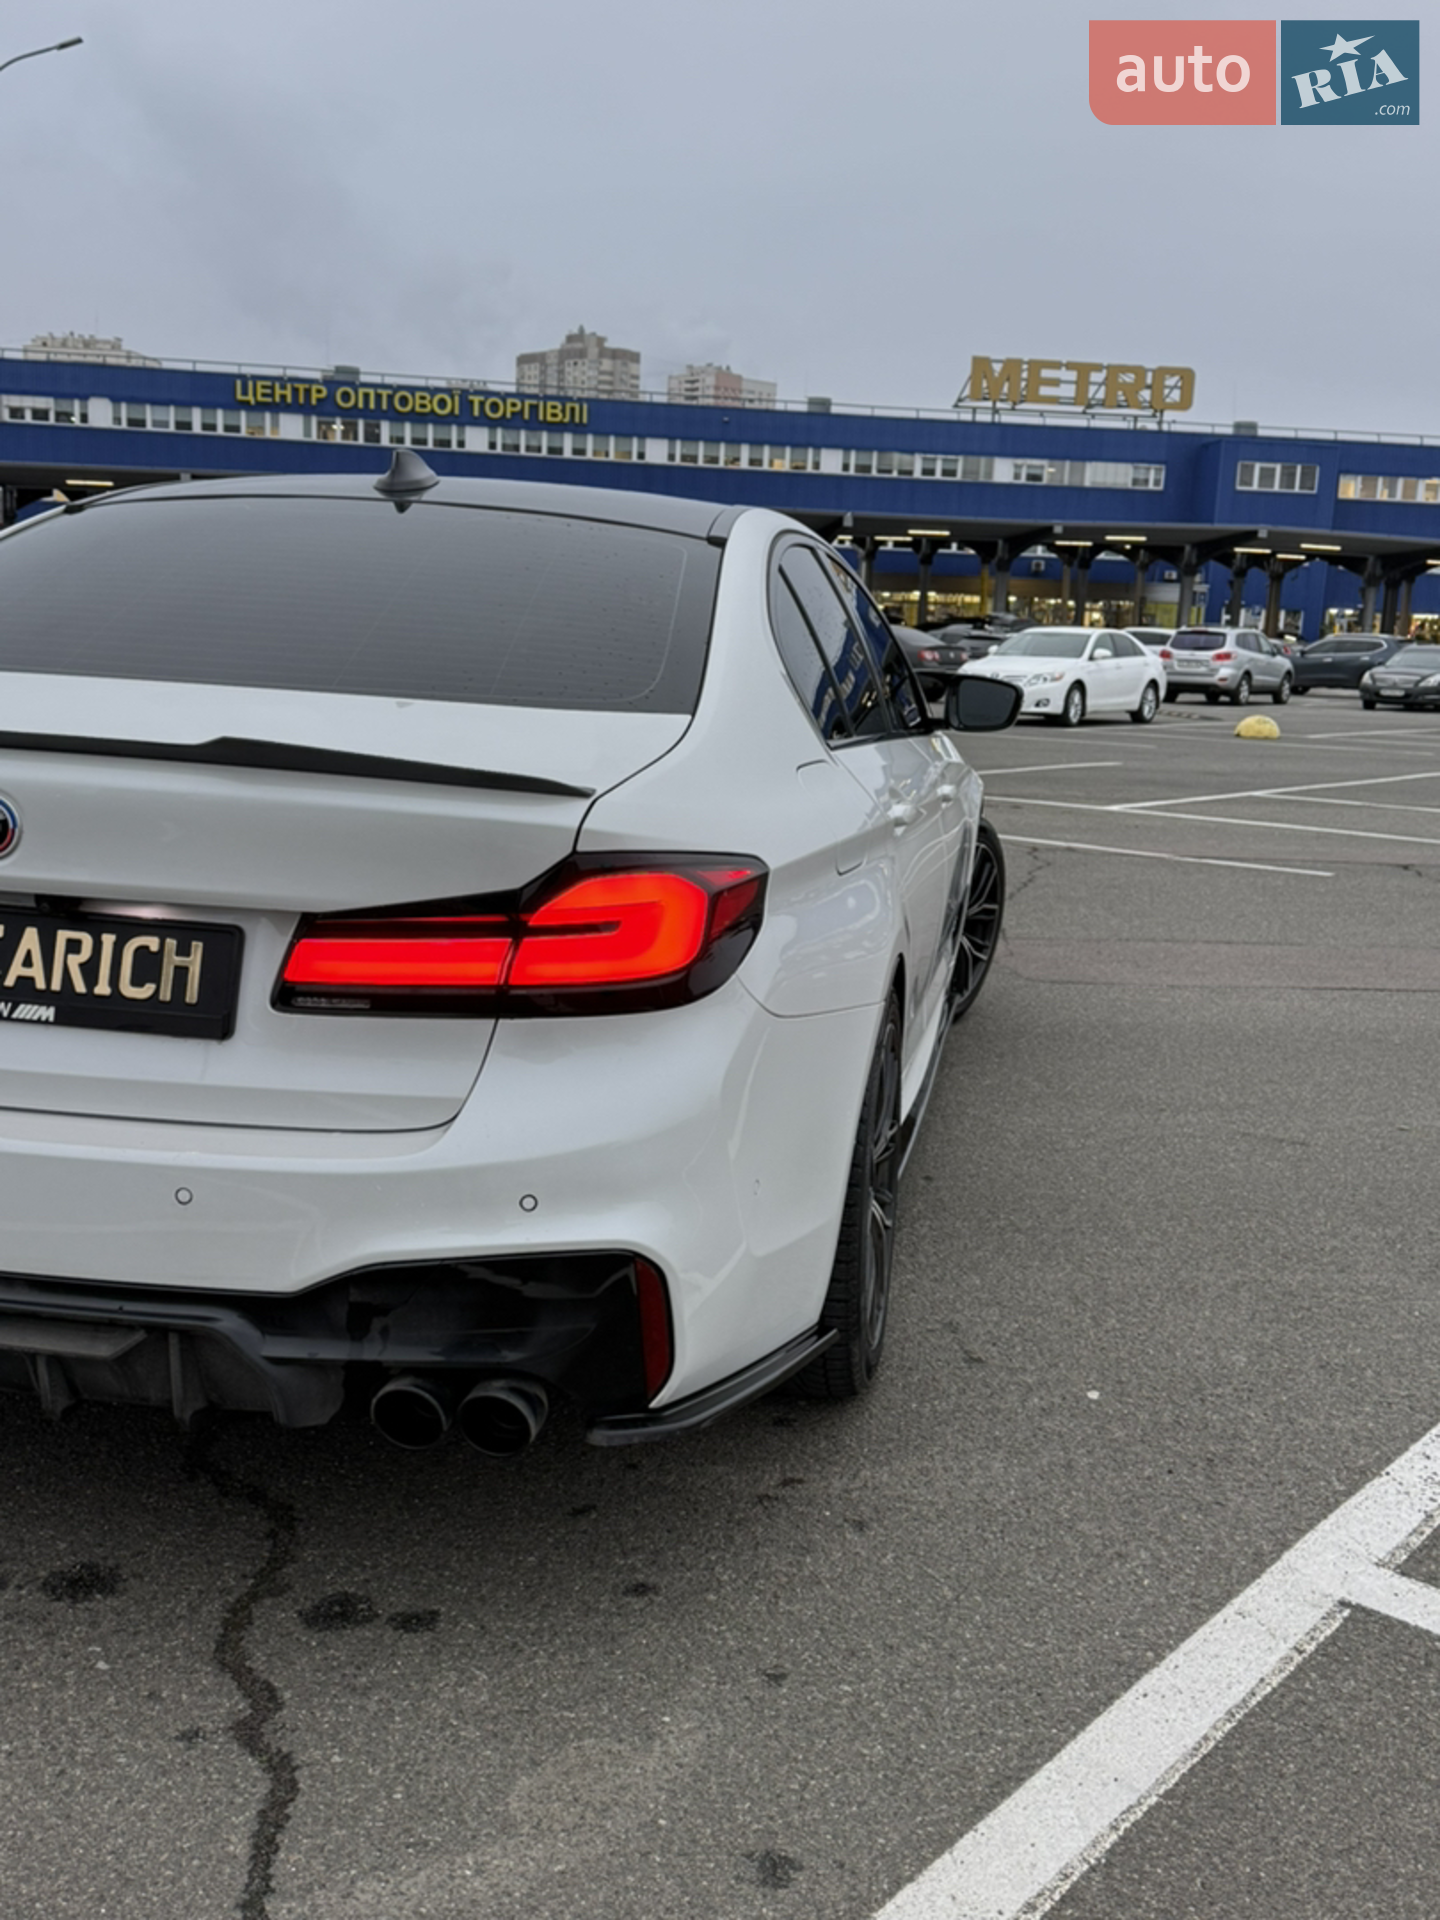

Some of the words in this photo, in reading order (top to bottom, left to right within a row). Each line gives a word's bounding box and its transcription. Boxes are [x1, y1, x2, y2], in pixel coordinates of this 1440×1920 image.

[235, 379, 327, 405] ЦЕНТР
[335, 386, 460, 415] ОПТОВОЇ
[468, 395, 588, 424] ТОРГІВЛІ
[969, 355, 1195, 411] METRO
[0, 924, 203, 1004] ARICH
